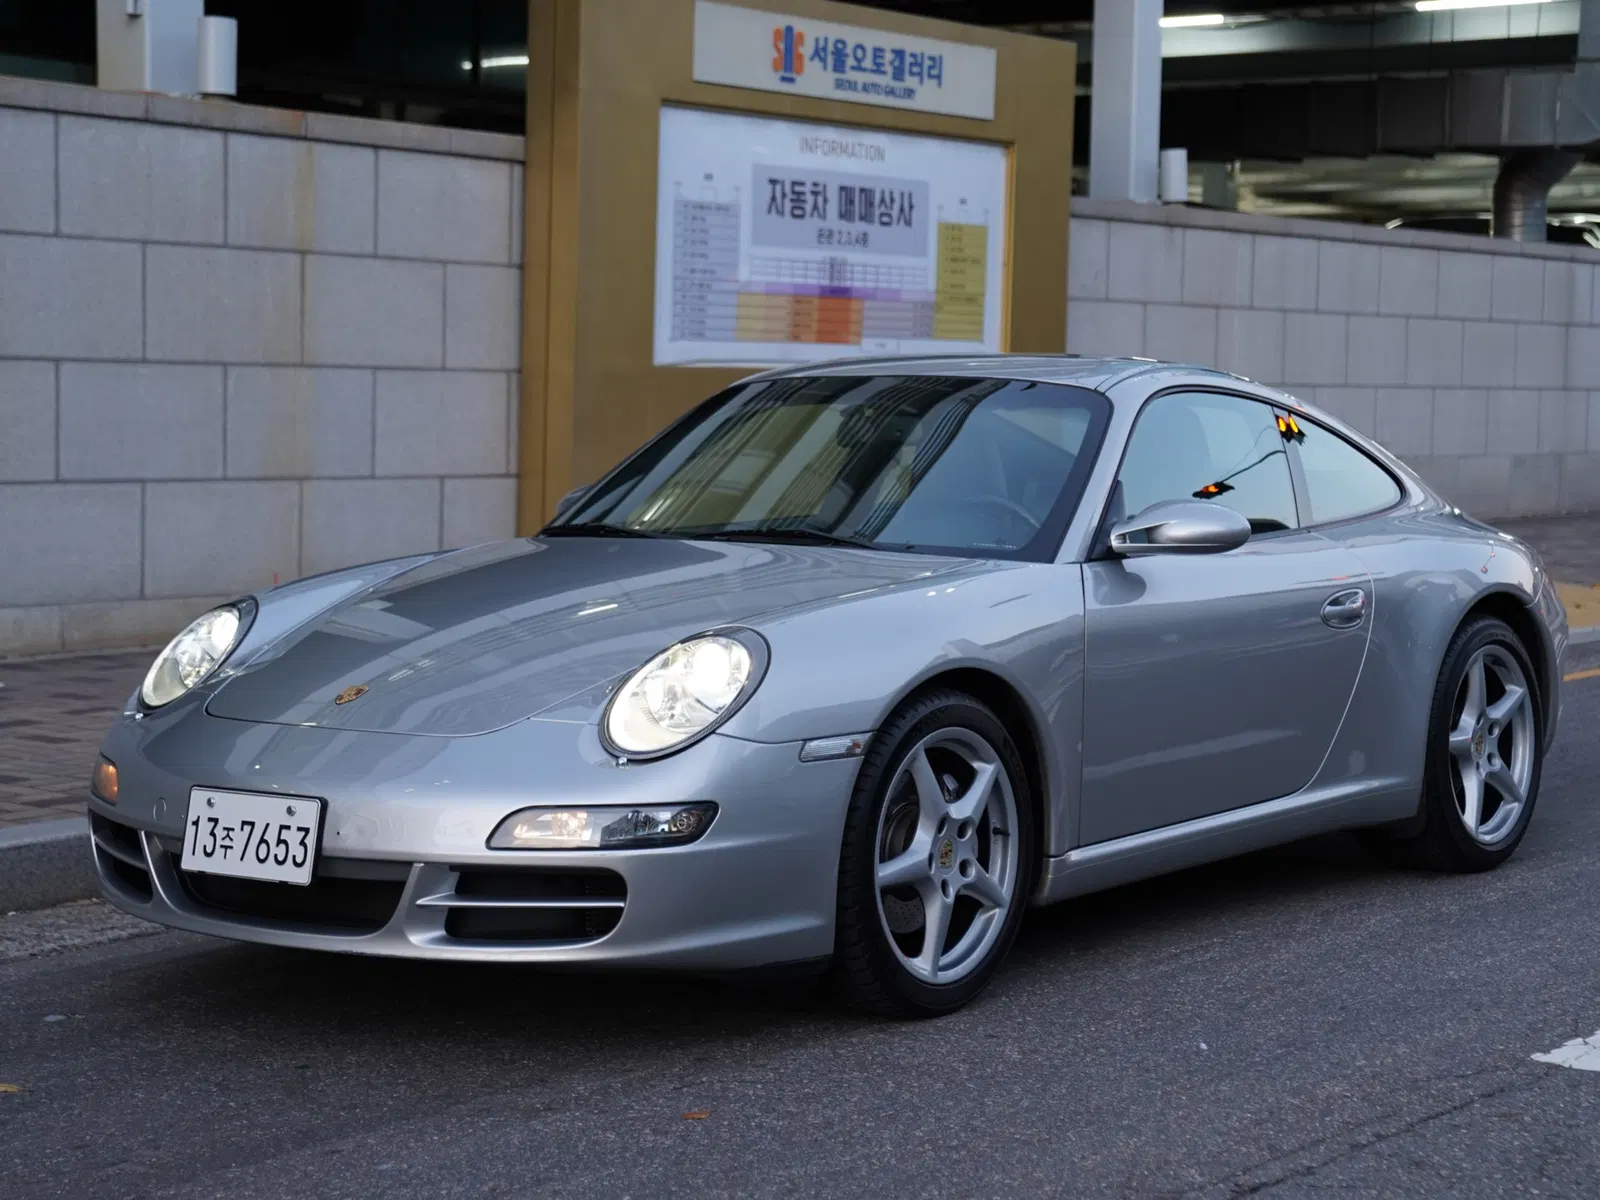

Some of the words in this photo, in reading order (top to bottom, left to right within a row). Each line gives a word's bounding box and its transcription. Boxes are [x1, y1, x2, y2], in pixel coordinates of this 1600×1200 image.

[809, 36, 944, 88] 서울오토갤러리
[861, 82, 884, 96] AUTO
[799, 136, 886, 163] INFORMATION
[767, 177, 829, 222] 자동차
[838, 184, 915, 228] 매매상사
